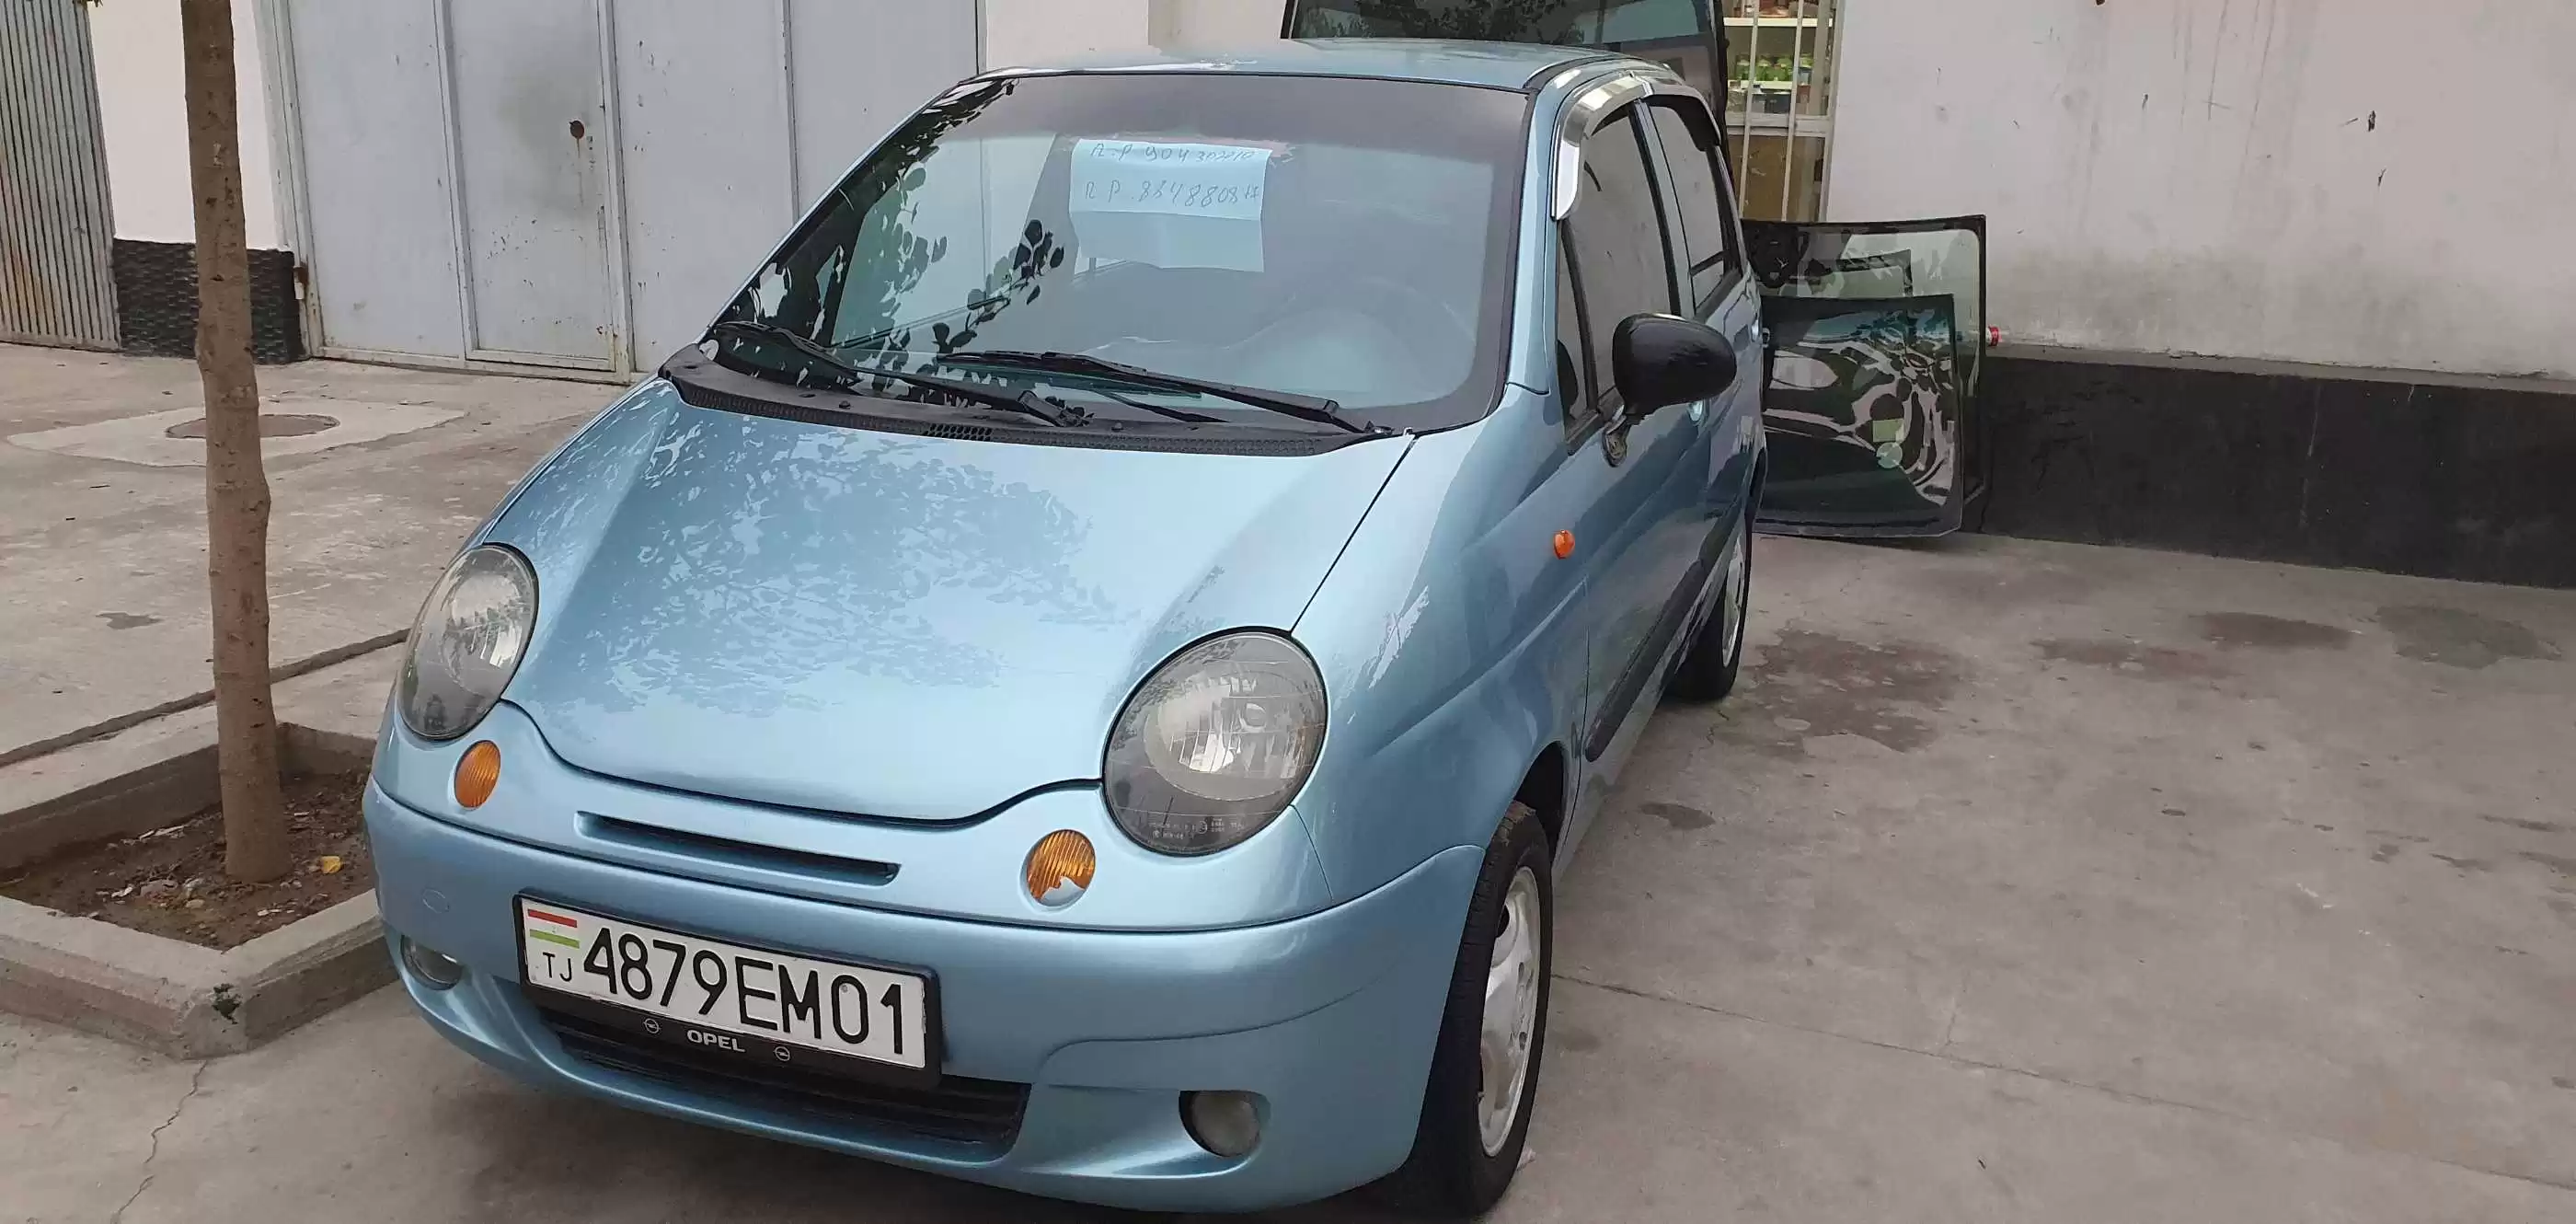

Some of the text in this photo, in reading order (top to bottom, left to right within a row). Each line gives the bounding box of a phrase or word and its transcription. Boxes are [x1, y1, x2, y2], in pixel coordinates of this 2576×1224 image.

[542, 952, 572, 982] TJ
[583, 927, 903, 1055] 4879EM01
[687, 1030, 746, 1053] OPEL
